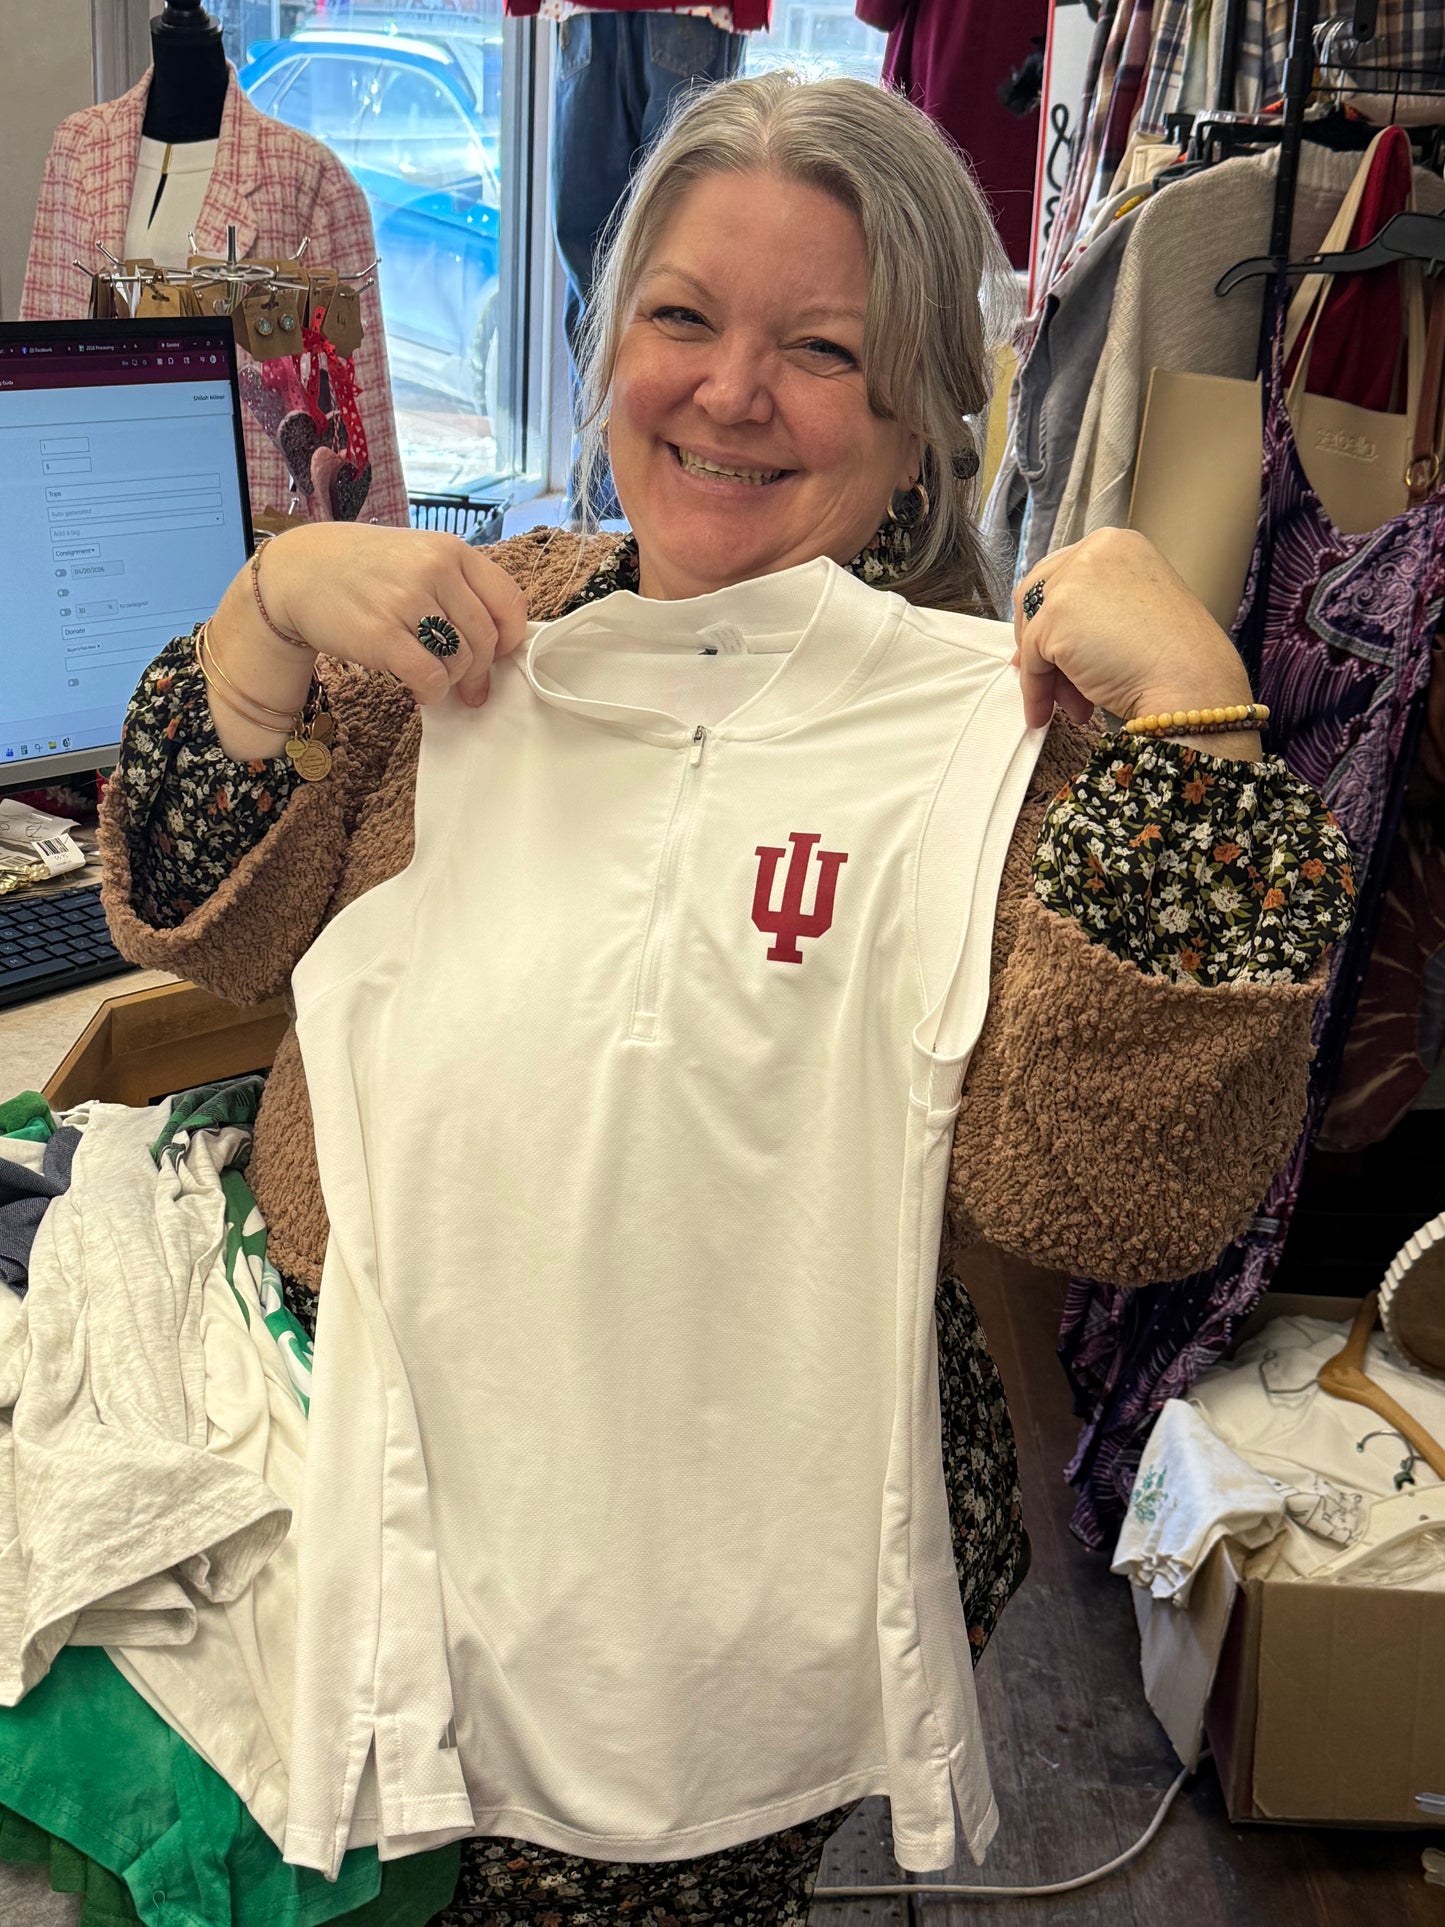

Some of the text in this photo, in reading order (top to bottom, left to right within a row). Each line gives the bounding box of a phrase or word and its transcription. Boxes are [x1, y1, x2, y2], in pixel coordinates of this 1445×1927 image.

[55, 547, 92, 557] Consignment
[64, 628, 86, 636] Donate
[751, 832, 848, 964] IU
